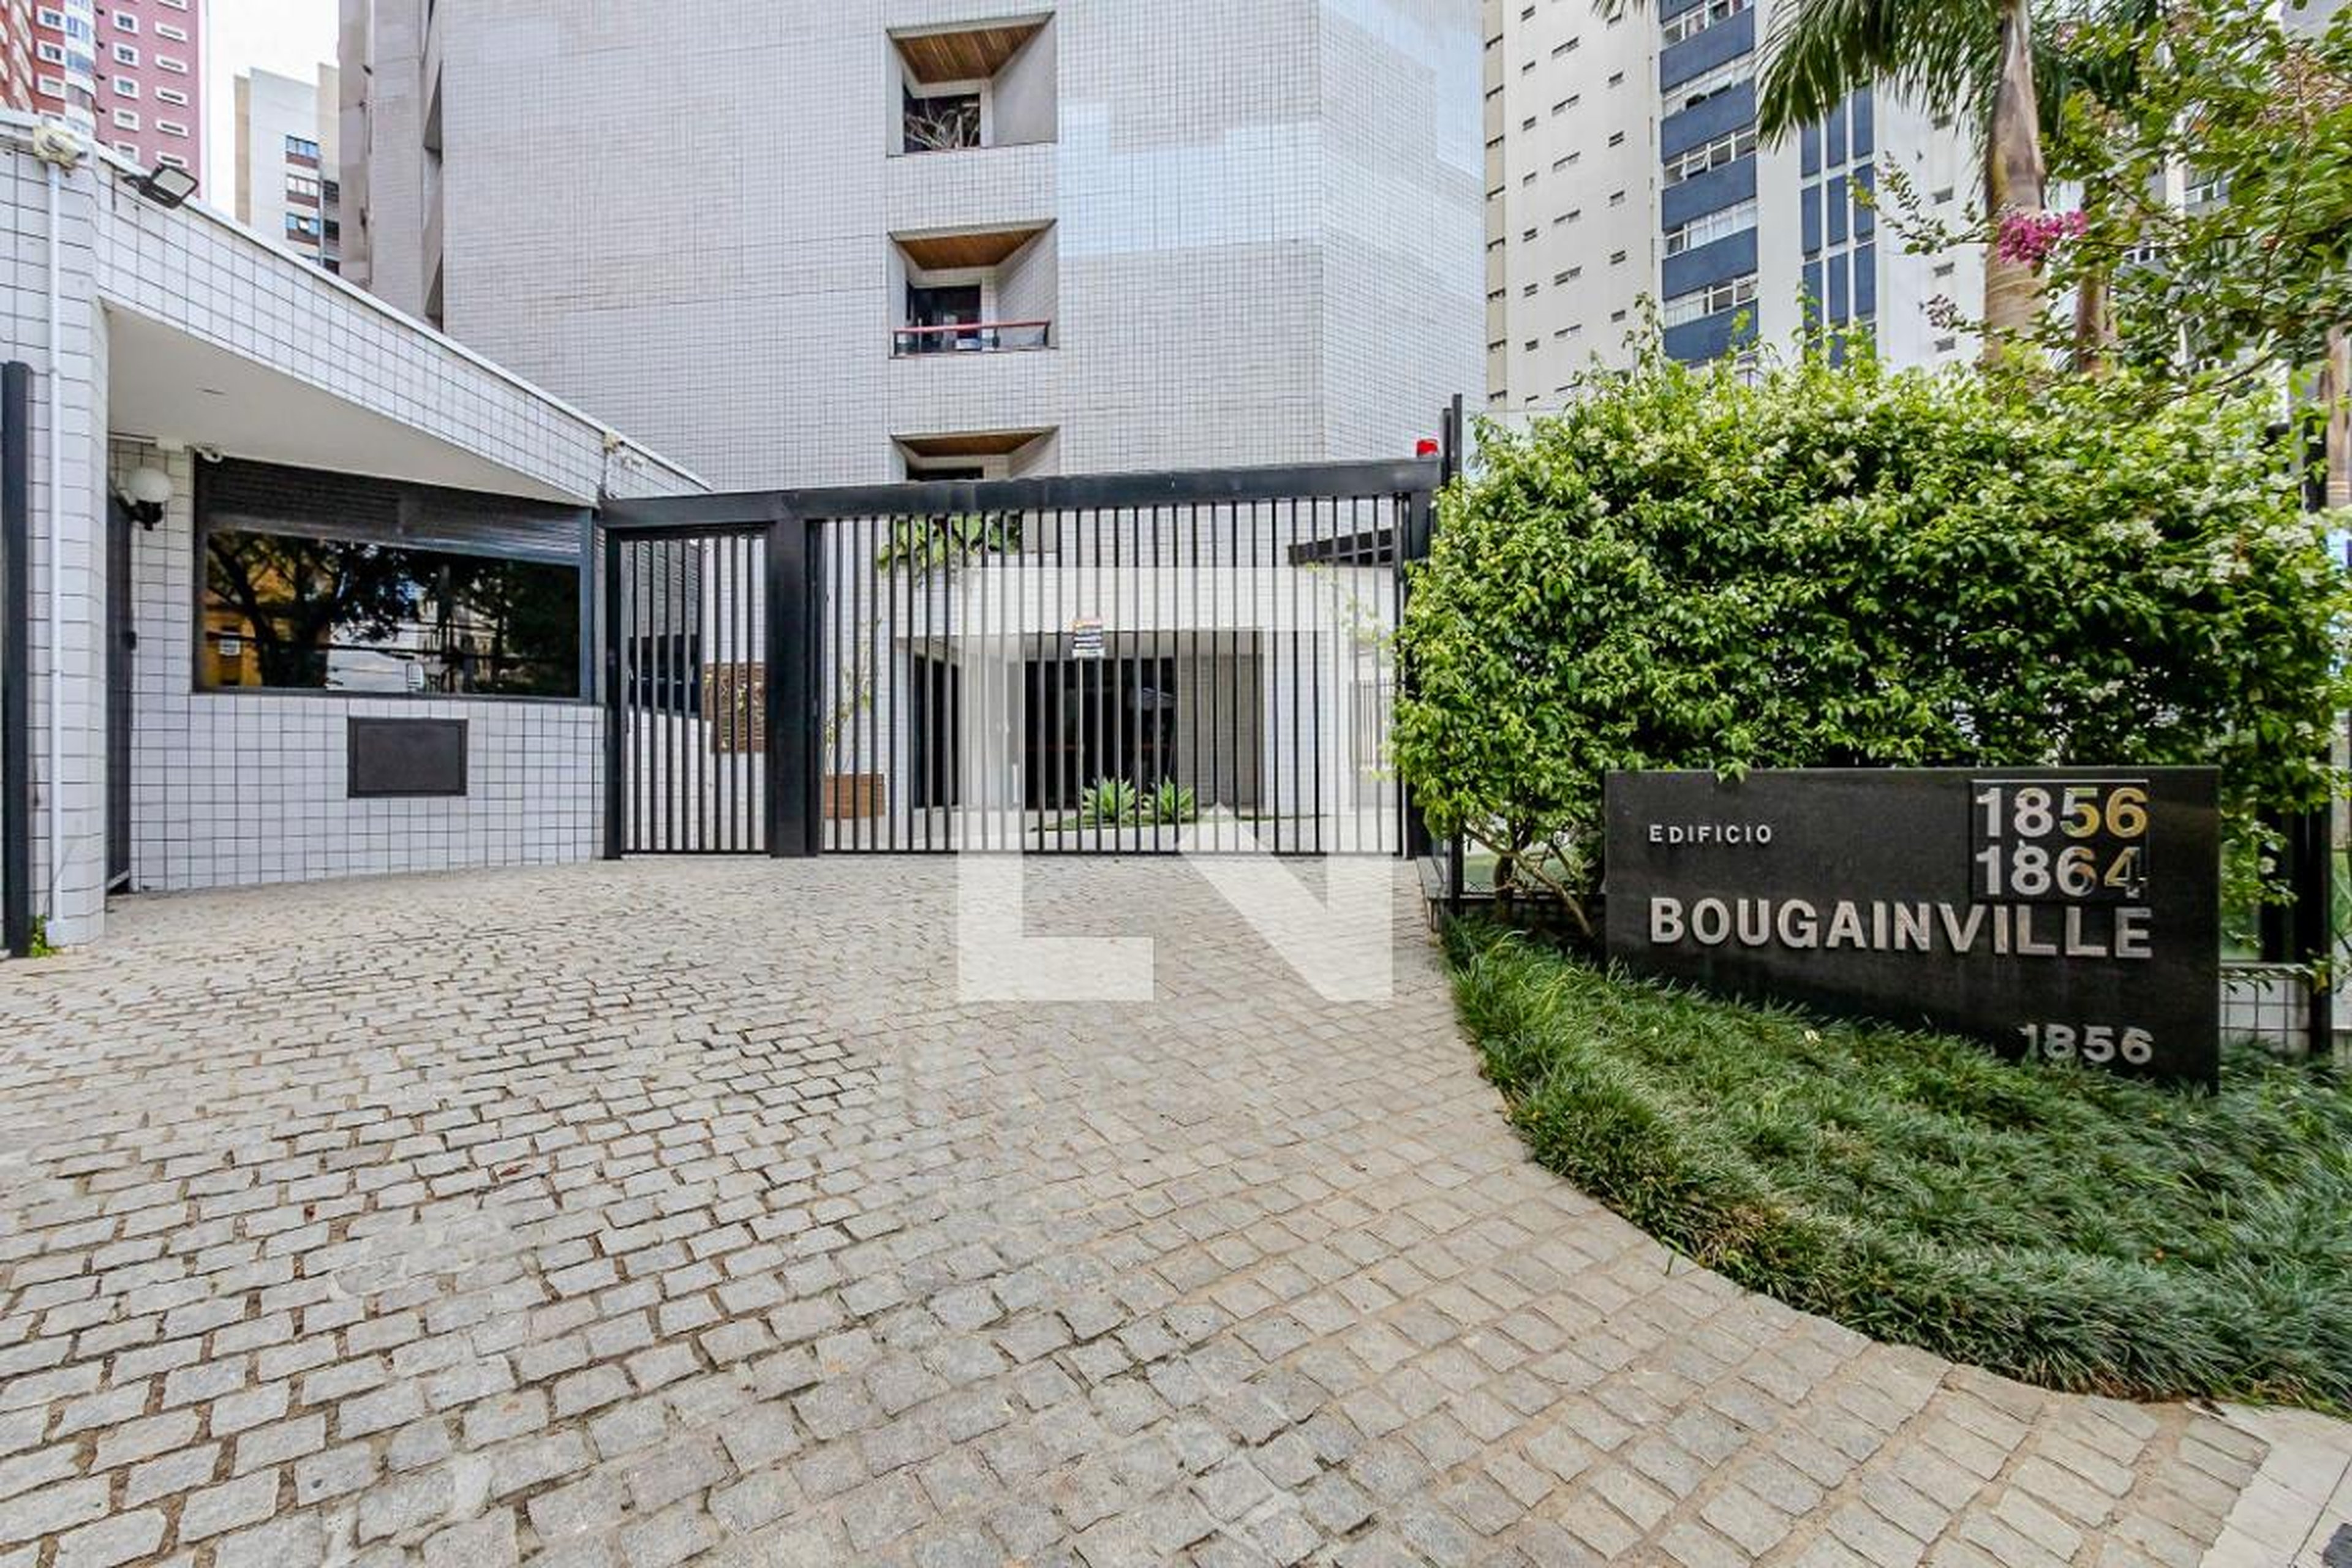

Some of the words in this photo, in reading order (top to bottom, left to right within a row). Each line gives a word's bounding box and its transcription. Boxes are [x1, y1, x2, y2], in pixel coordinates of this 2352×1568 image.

[1649, 824, 1772, 844] EDIFICIO
[1975, 786, 2148, 839] 1856
[1975, 844, 2147, 899] 1864
[1650, 897, 2154, 958] BOUGAINVILLE
[2018, 1023, 2154, 1065] 1856
